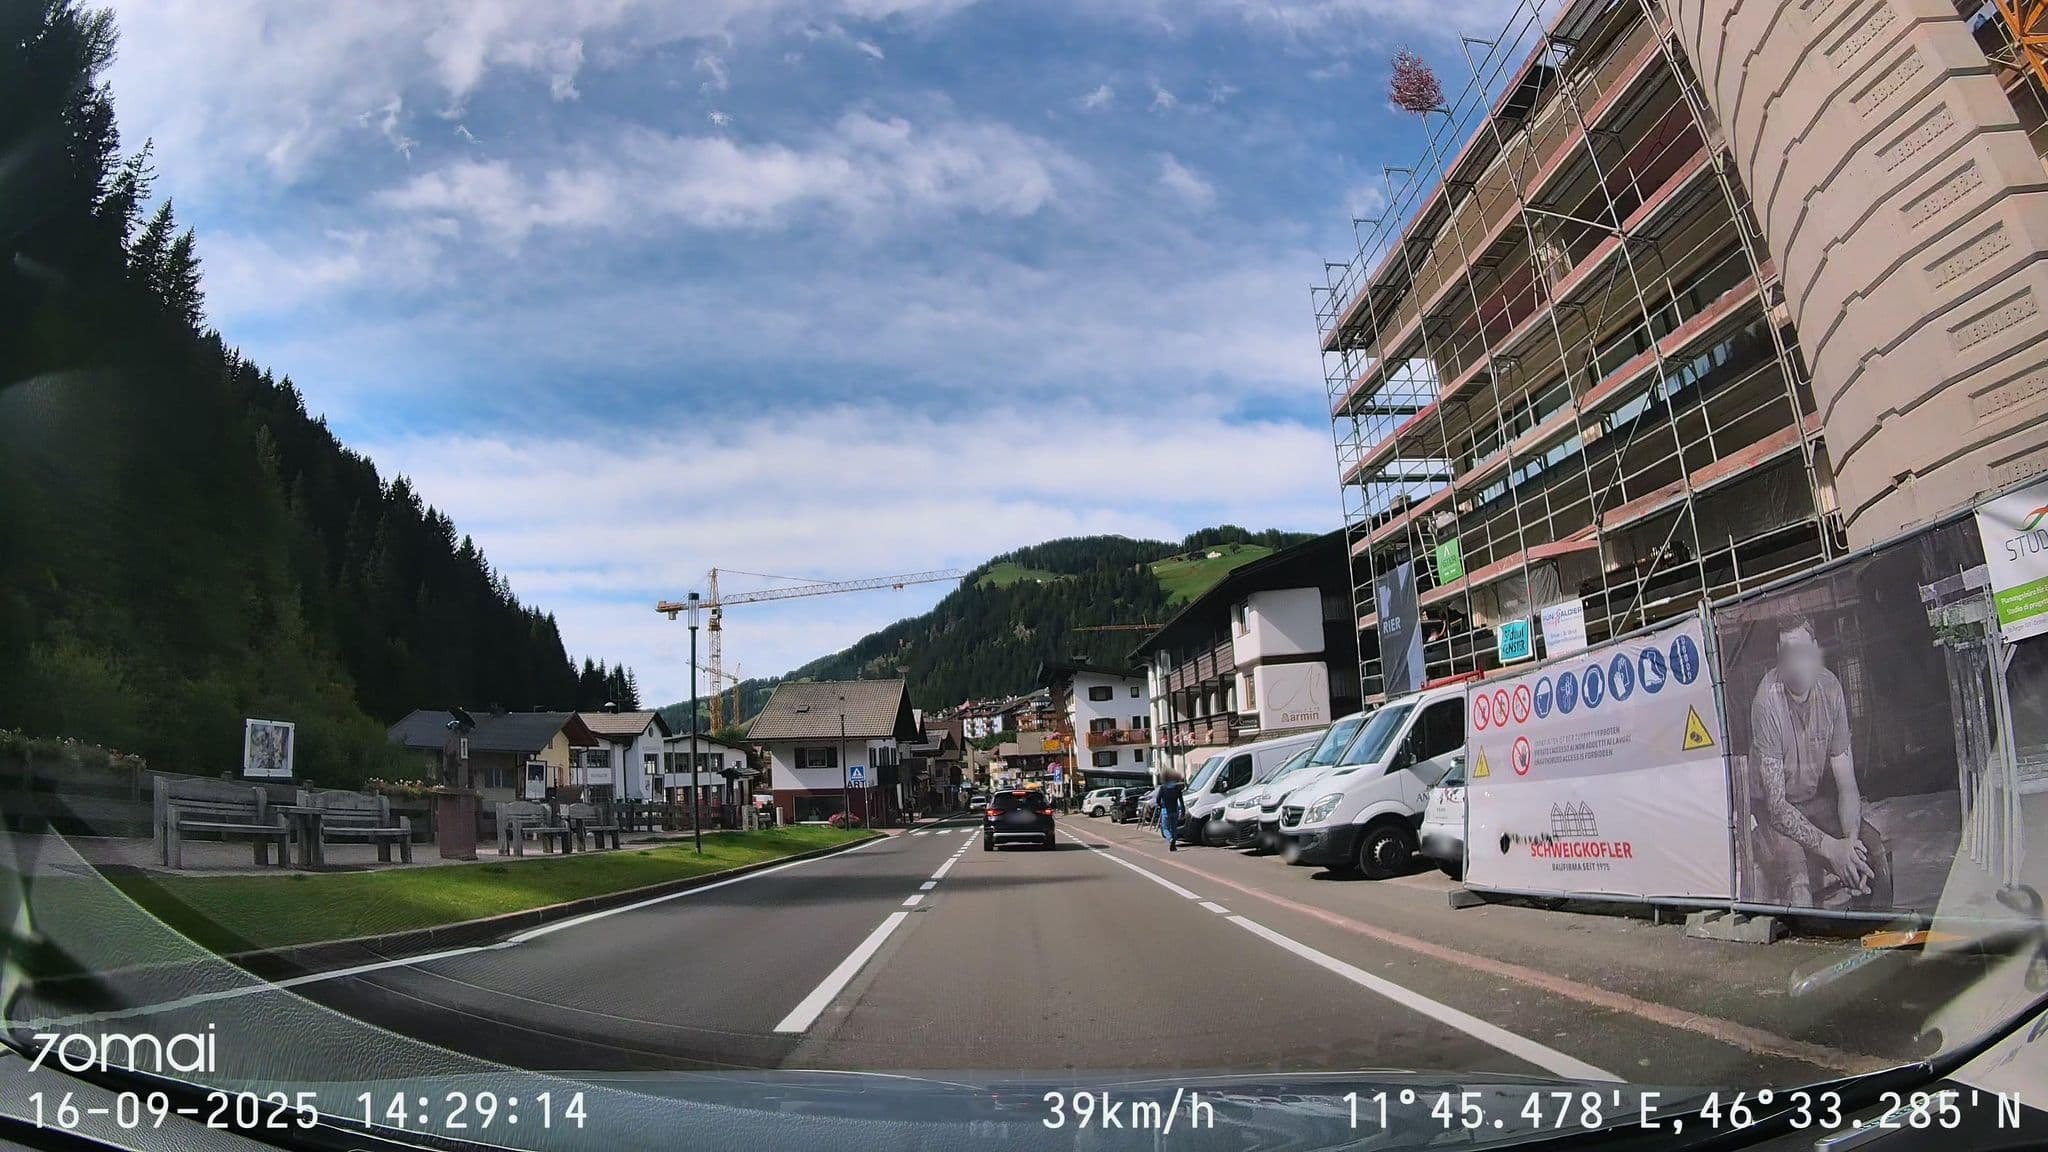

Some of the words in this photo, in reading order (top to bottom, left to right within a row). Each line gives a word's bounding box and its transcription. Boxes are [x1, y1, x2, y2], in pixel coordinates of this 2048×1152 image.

[1383, 617, 1401, 634] RIER
[1531, 841, 1633, 858] SCHWEIGKOFLER
[1552, 863, 1582, 871] BAUFIRMA
[1582, 862, 1596, 871] SEIT
